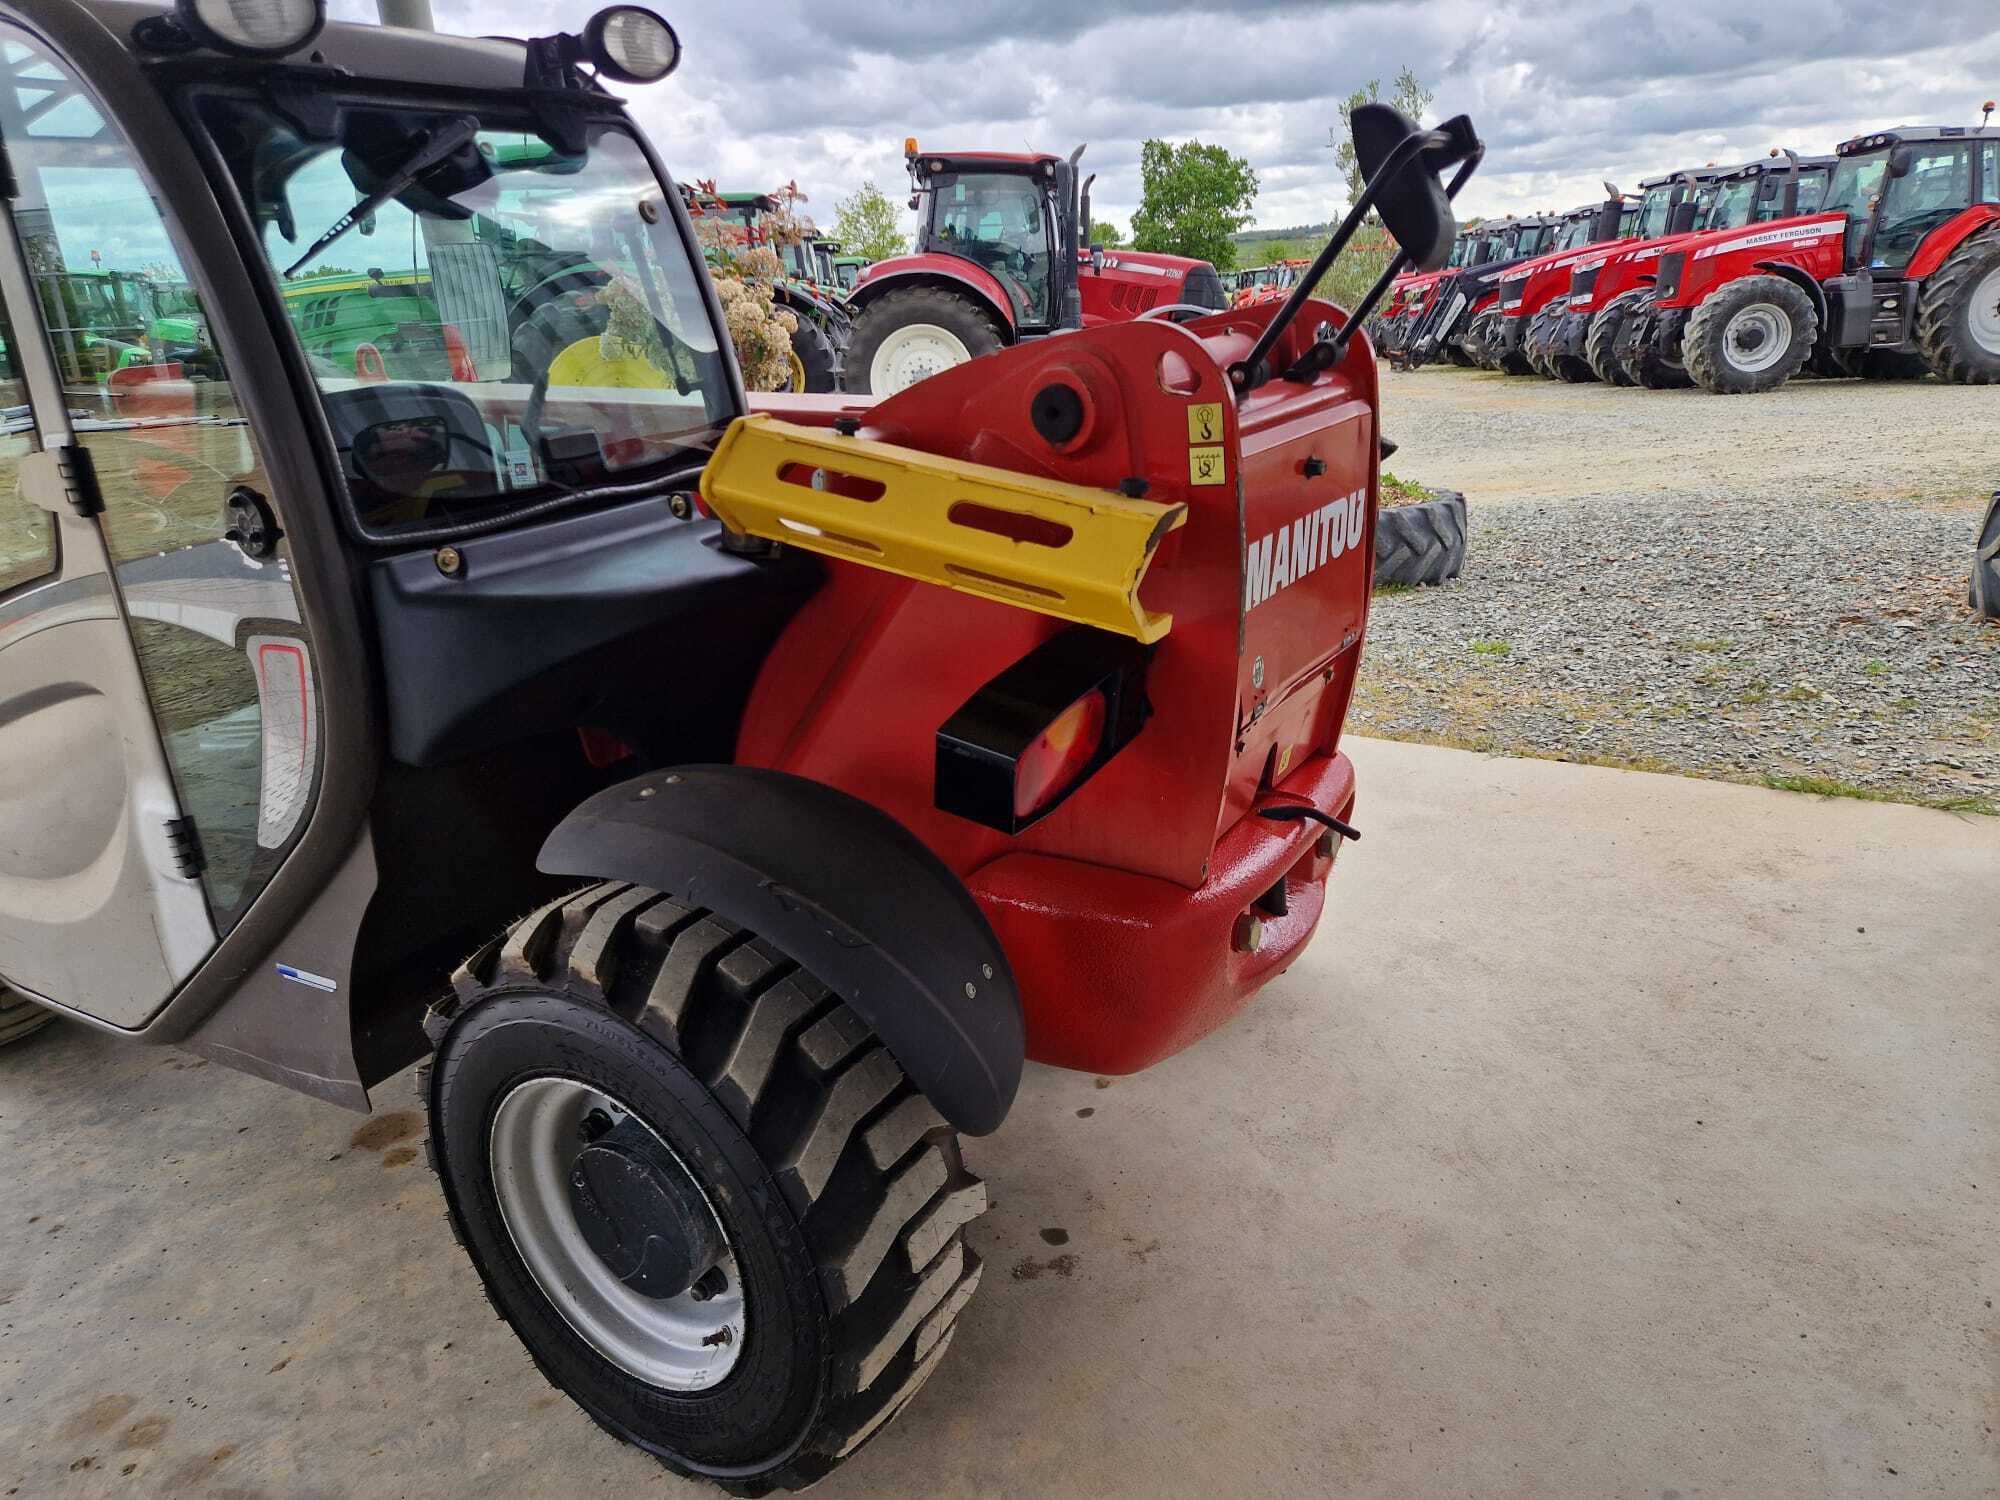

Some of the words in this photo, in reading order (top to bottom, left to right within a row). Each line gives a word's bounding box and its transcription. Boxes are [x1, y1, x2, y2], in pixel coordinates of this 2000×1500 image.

[1745, 233, 1778, 246] MASSEY
[1780, 226, 1822, 240] FERGUSON
[1245, 487, 1367, 613] MANITOU
